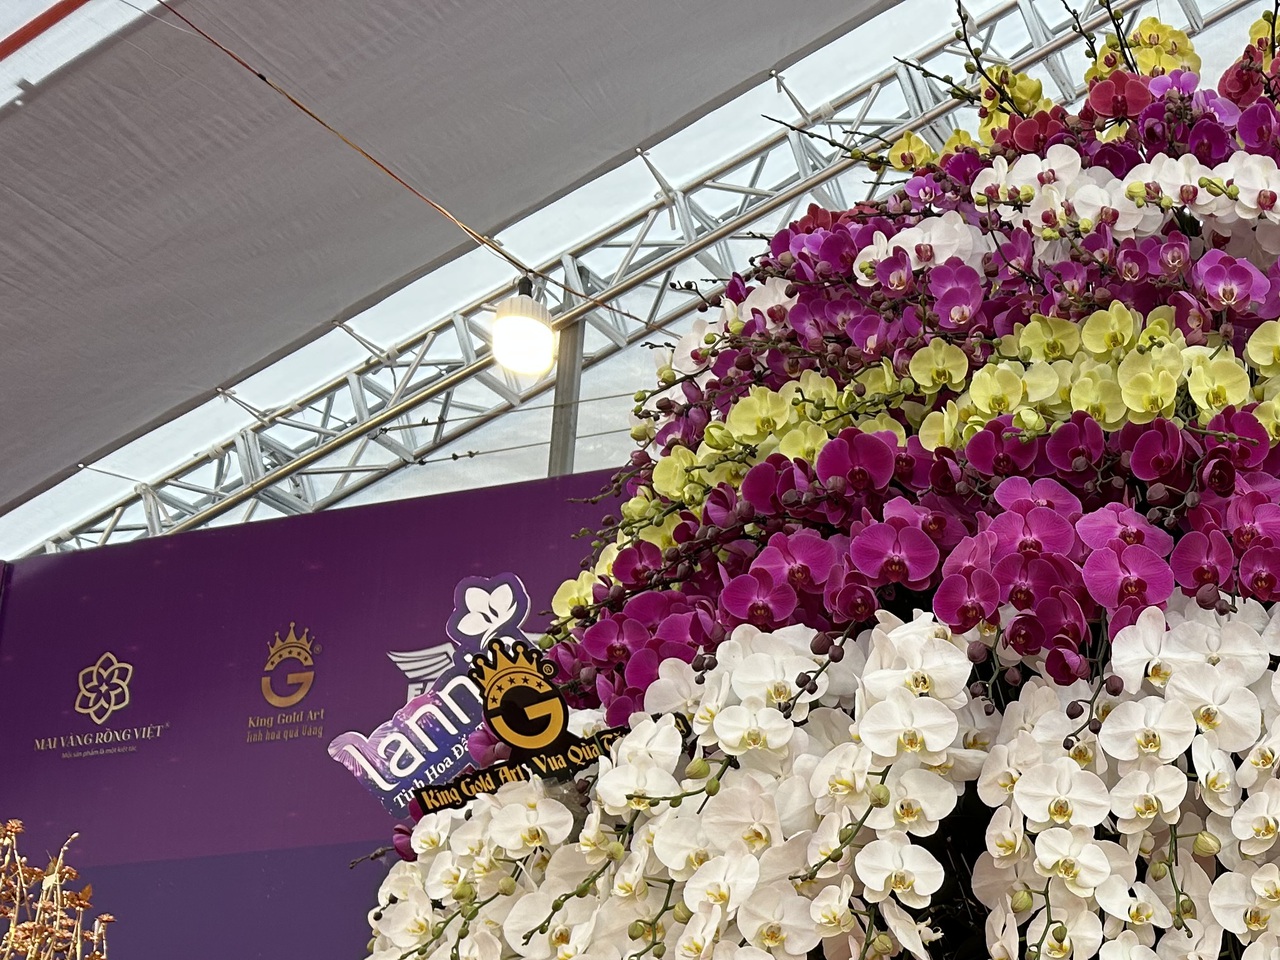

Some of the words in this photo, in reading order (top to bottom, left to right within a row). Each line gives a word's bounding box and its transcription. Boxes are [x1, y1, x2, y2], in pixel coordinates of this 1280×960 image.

[34, 737, 57, 751] MAI
[60, 732, 93, 748] VÀNG
[133, 723, 164, 740] VIỆT
[248, 716, 273, 728] King
[277, 711, 303, 724] Gold
[306, 708, 325, 720] Art
[339, 668, 485, 792] lann
[421, 788, 463, 810] King
[460, 773, 496, 797] Gold
[531, 752, 568, 774] Vua
[424, 757, 454, 784] Hoa
[451, 734, 469, 759] Đấ
